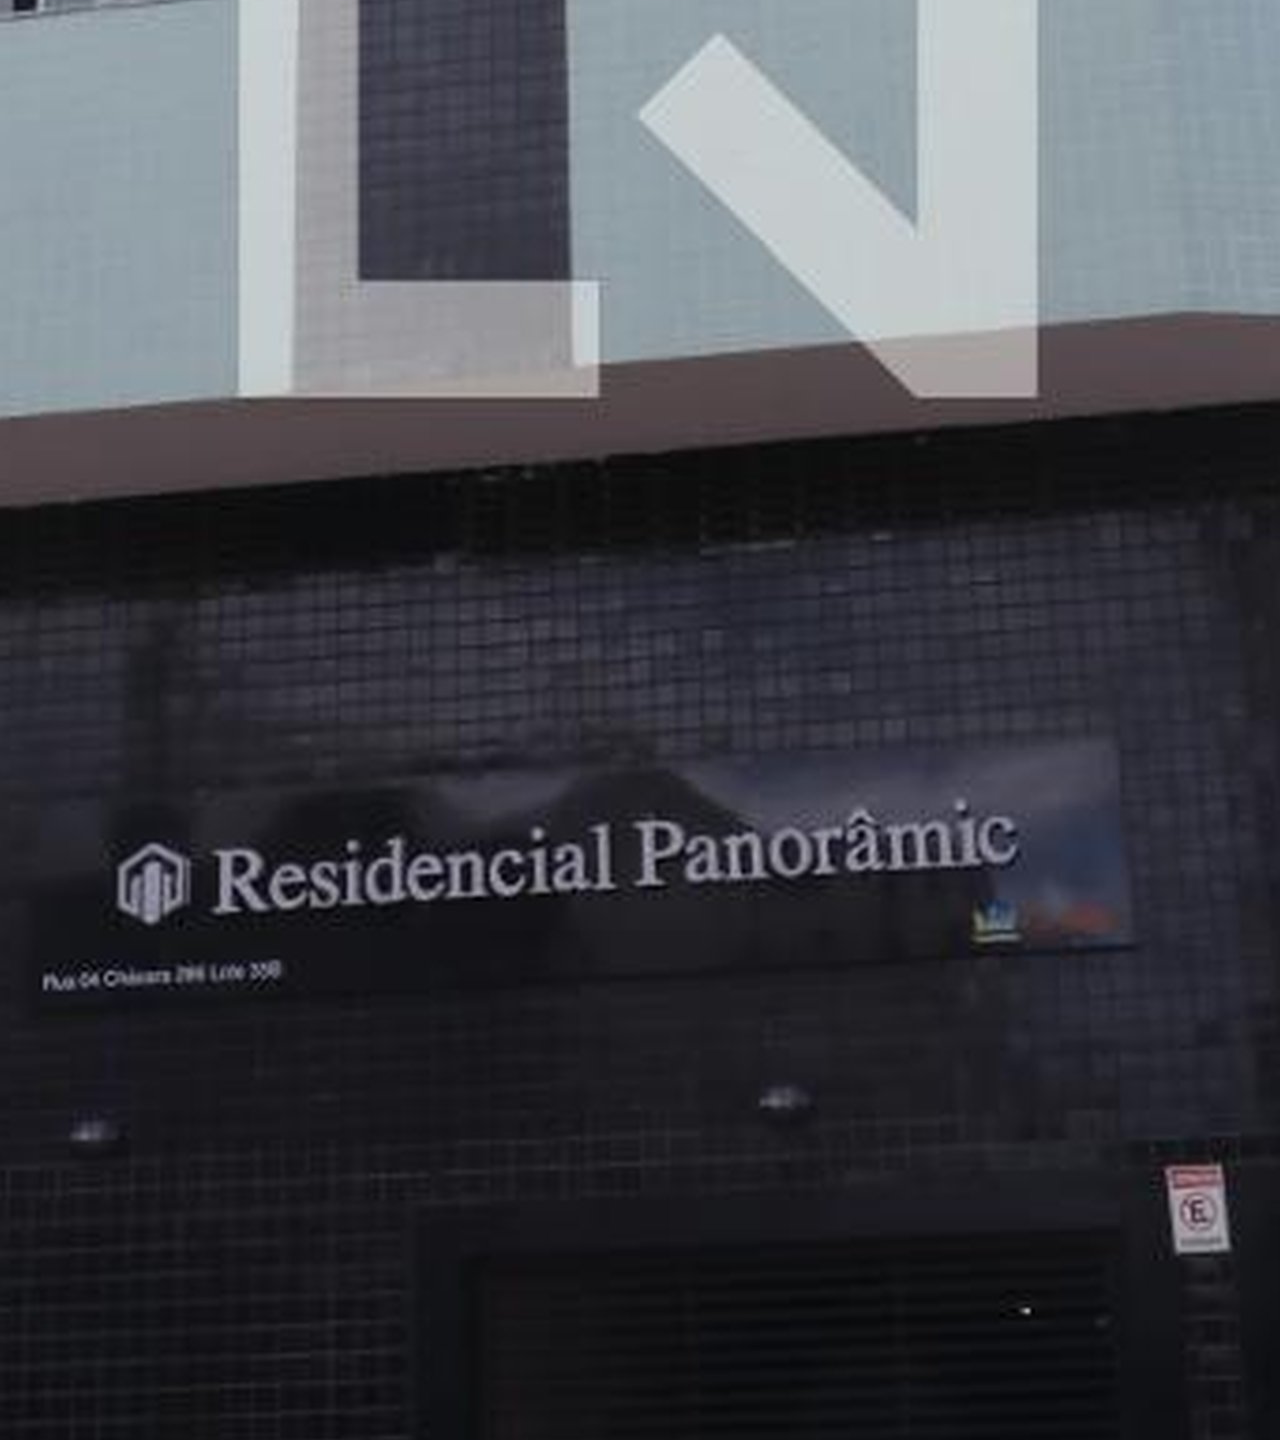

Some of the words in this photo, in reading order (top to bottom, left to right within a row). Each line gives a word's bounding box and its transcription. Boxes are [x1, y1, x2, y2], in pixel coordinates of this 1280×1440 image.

[213, 823, 613, 915] Residencial
[635, 801, 1019, 887] Panorâmic
[42, 972, 74, 990] Rua
